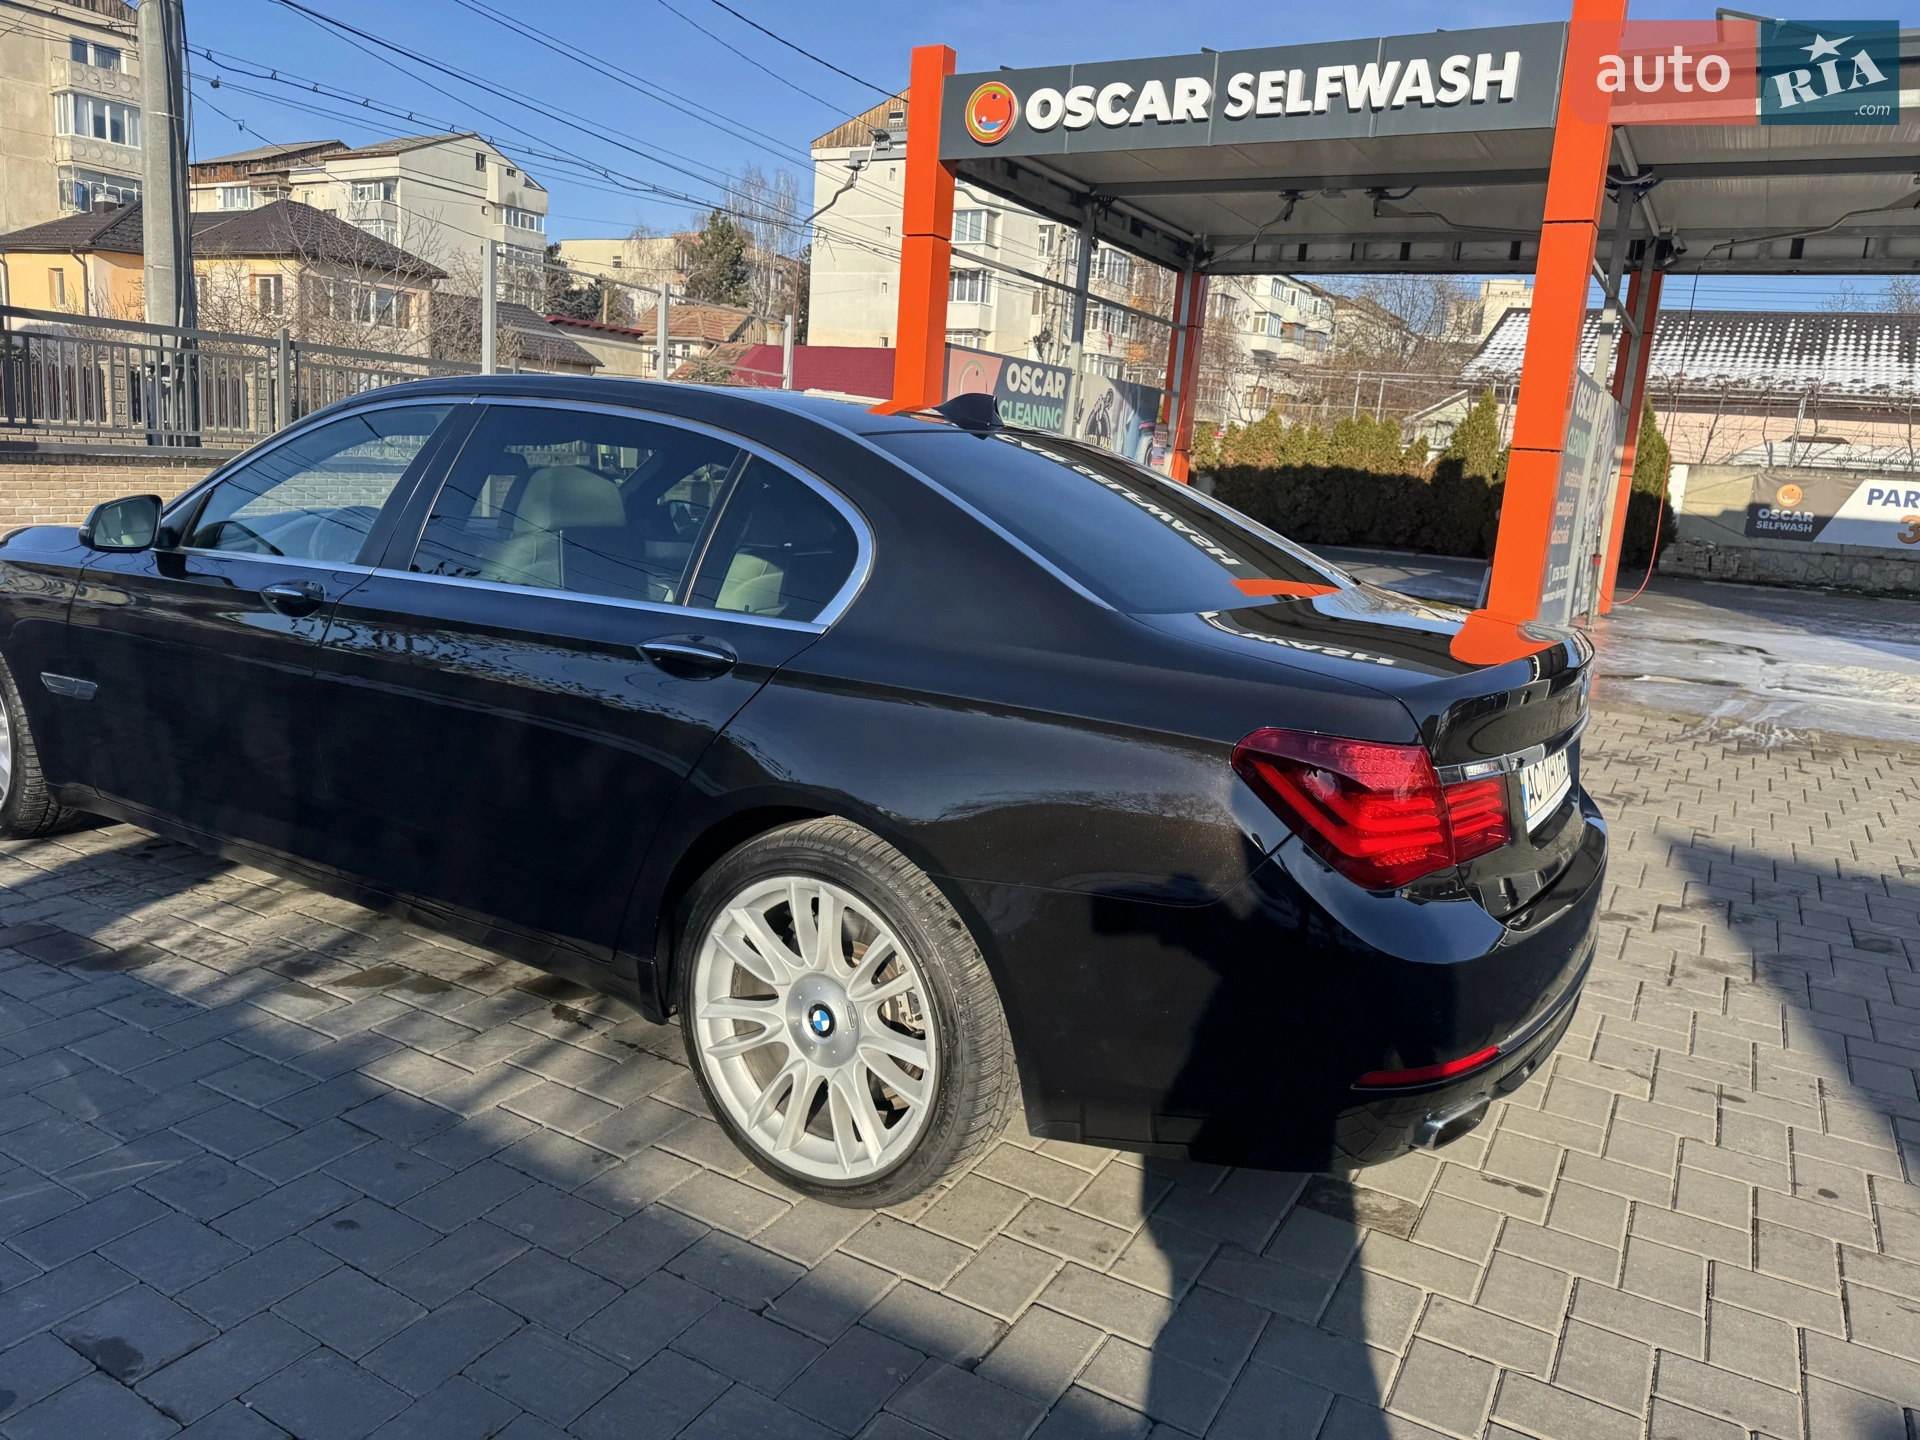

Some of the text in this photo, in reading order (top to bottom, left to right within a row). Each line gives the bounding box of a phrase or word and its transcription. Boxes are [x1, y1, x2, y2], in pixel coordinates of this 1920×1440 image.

[1025, 51, 1521, 131] OSCAR SELFWASH
[1007, 363, 1066, 399] OSCAR
[998, 400, 1063, 429] CLEANING
[1756, 521, 1813, 532] SELFWASH
[1757, 508, 1814, 522] OSCAR
